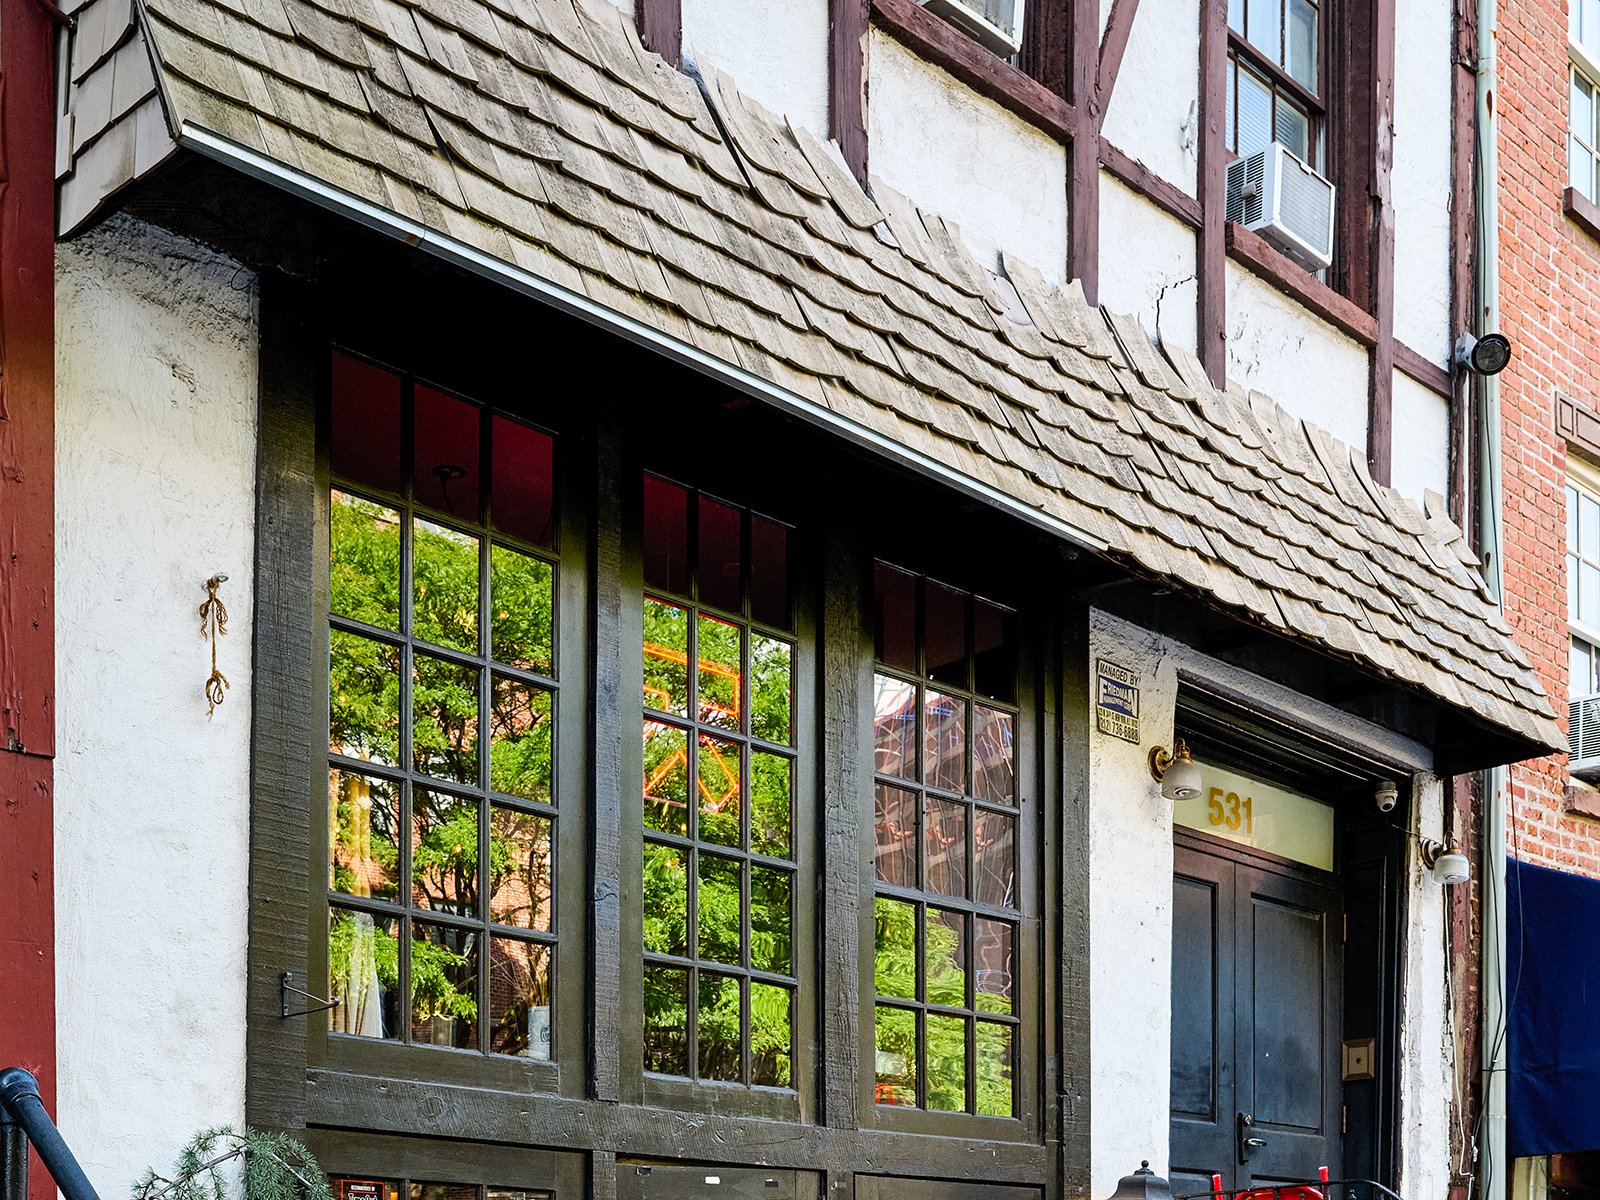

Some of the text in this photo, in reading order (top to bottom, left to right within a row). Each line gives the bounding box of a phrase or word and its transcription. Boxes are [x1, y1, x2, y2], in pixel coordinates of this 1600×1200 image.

[1100, 661, 1139, 686] MANAGED BY
[1099, 677, 1138, 717] FRIEDMAN
[1208, 786, 1252, 833] 531
